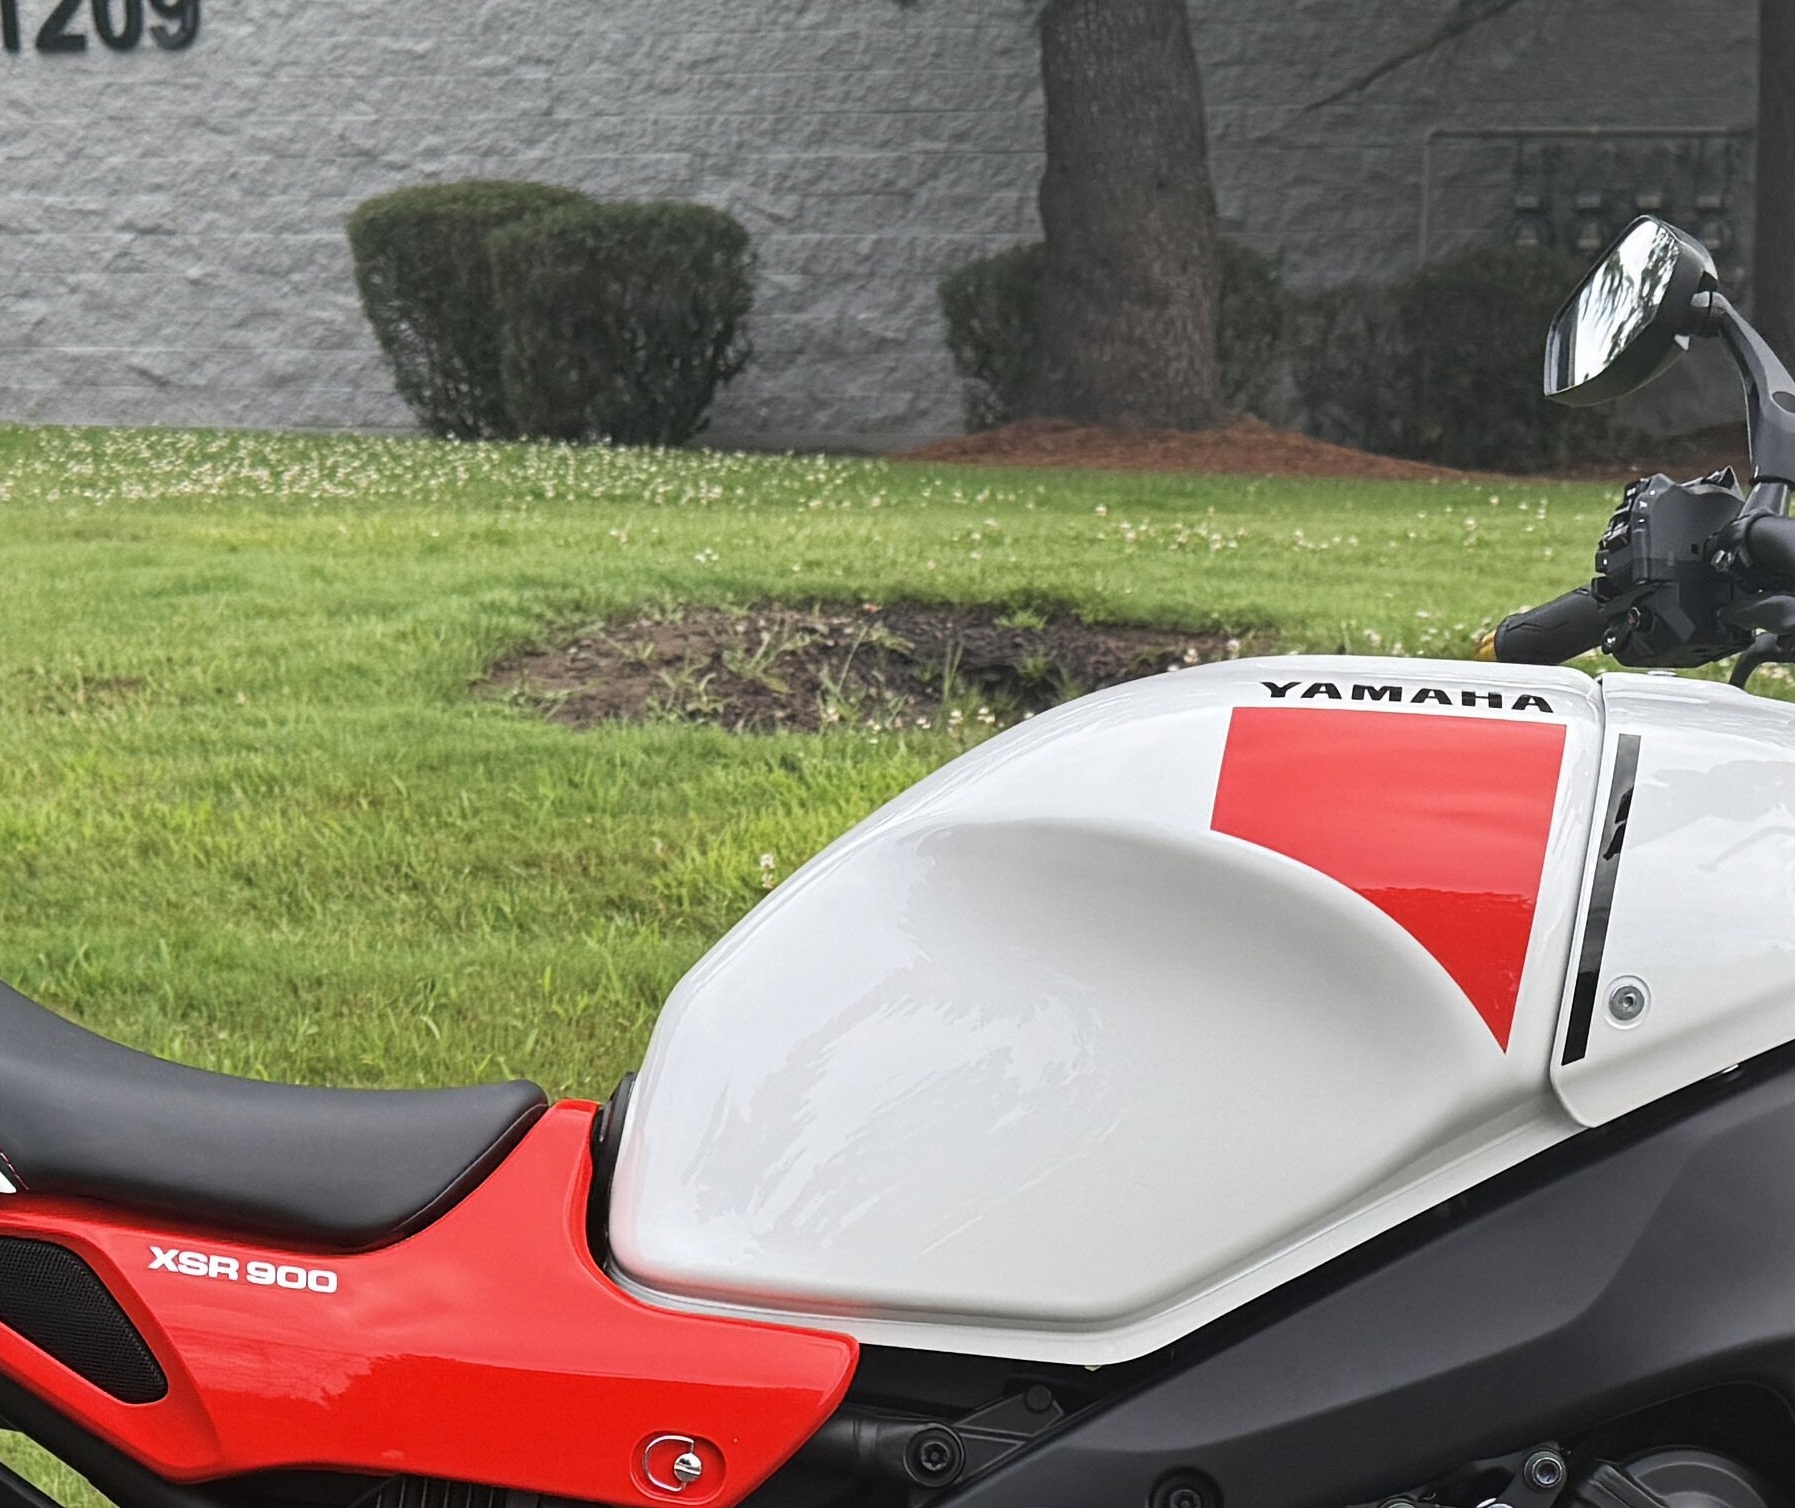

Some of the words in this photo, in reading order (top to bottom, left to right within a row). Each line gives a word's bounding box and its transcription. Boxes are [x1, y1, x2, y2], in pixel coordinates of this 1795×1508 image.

[1259, 680, 1555, 714] YAMAHA
[148, 1245, 240, 1281] XSR
[246, 1261, 338, 1294] 900
